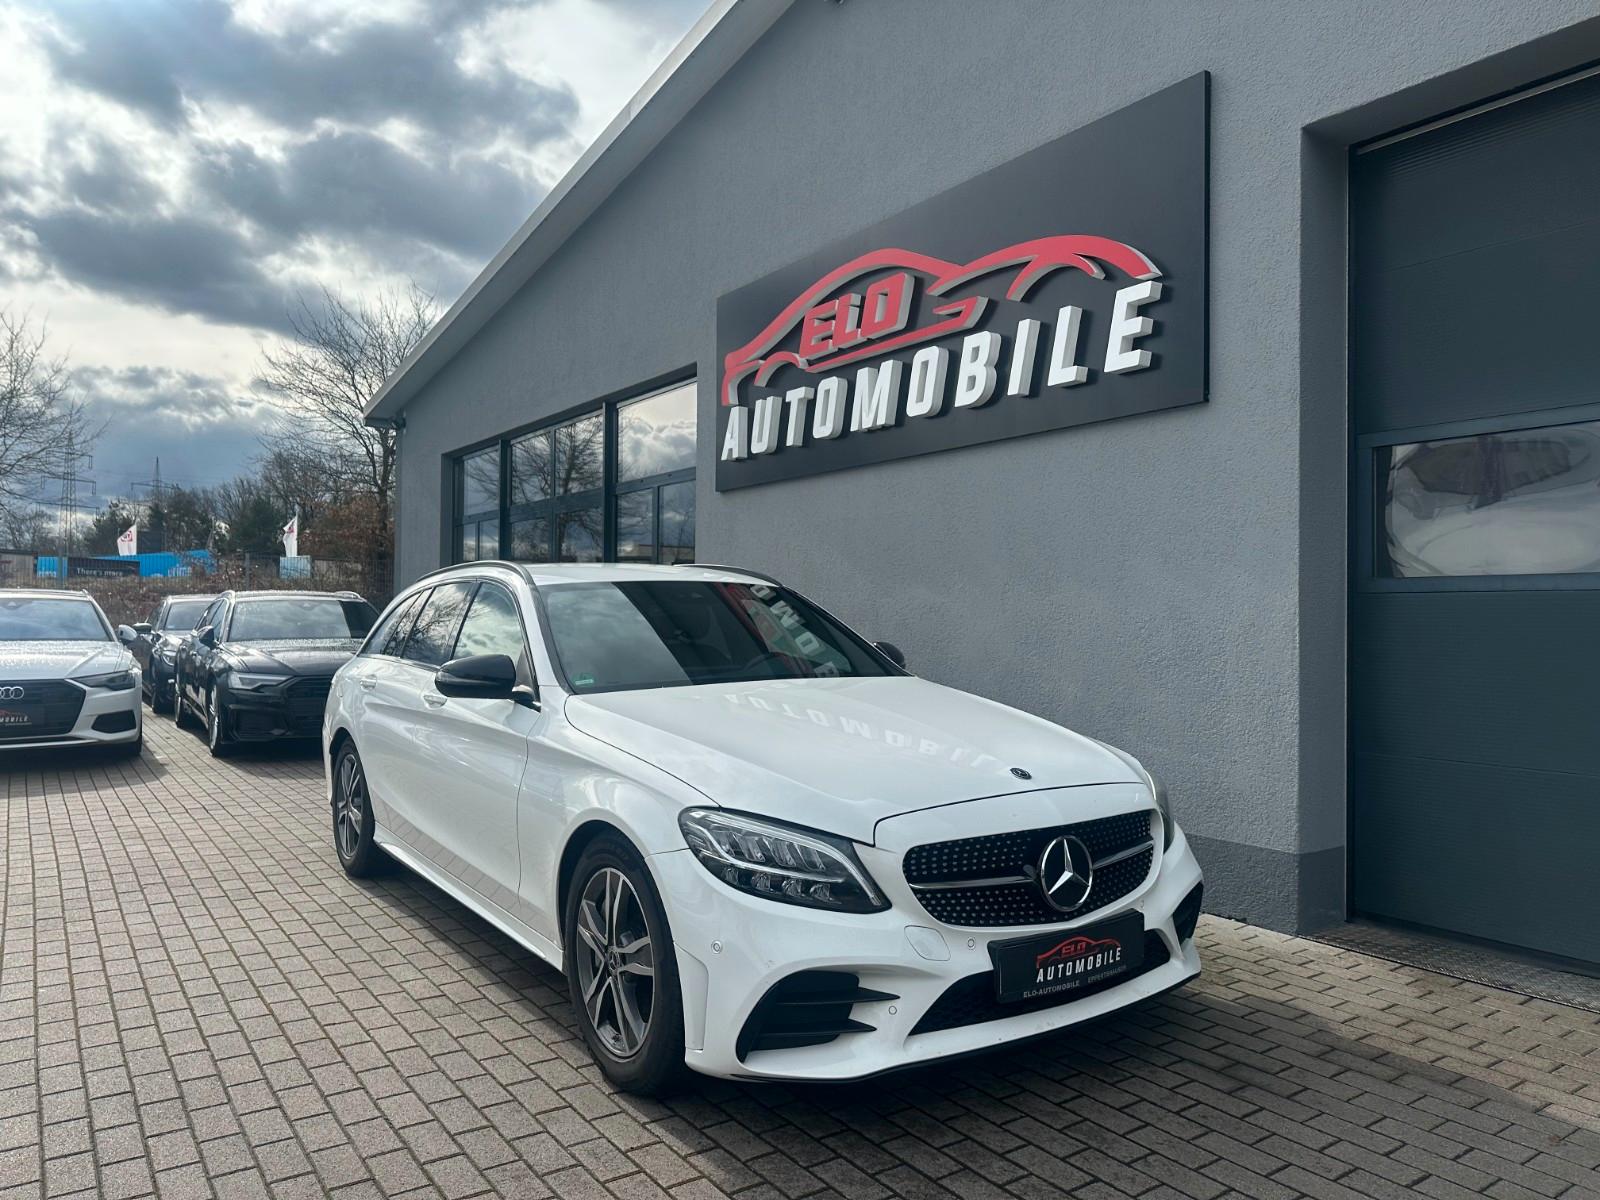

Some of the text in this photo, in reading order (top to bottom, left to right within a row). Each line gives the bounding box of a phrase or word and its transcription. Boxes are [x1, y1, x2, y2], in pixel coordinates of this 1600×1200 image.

[799, 272, 915, 359] ELO
[721, 279, 1163, 461] AUTOMOBILE
[1036, 947, 1122, 983] AUTOMOBILE
[1061, 942, 1086, 957] ELO
[1023, 980, 1080, 998] ELO-AUTOMOBILE
